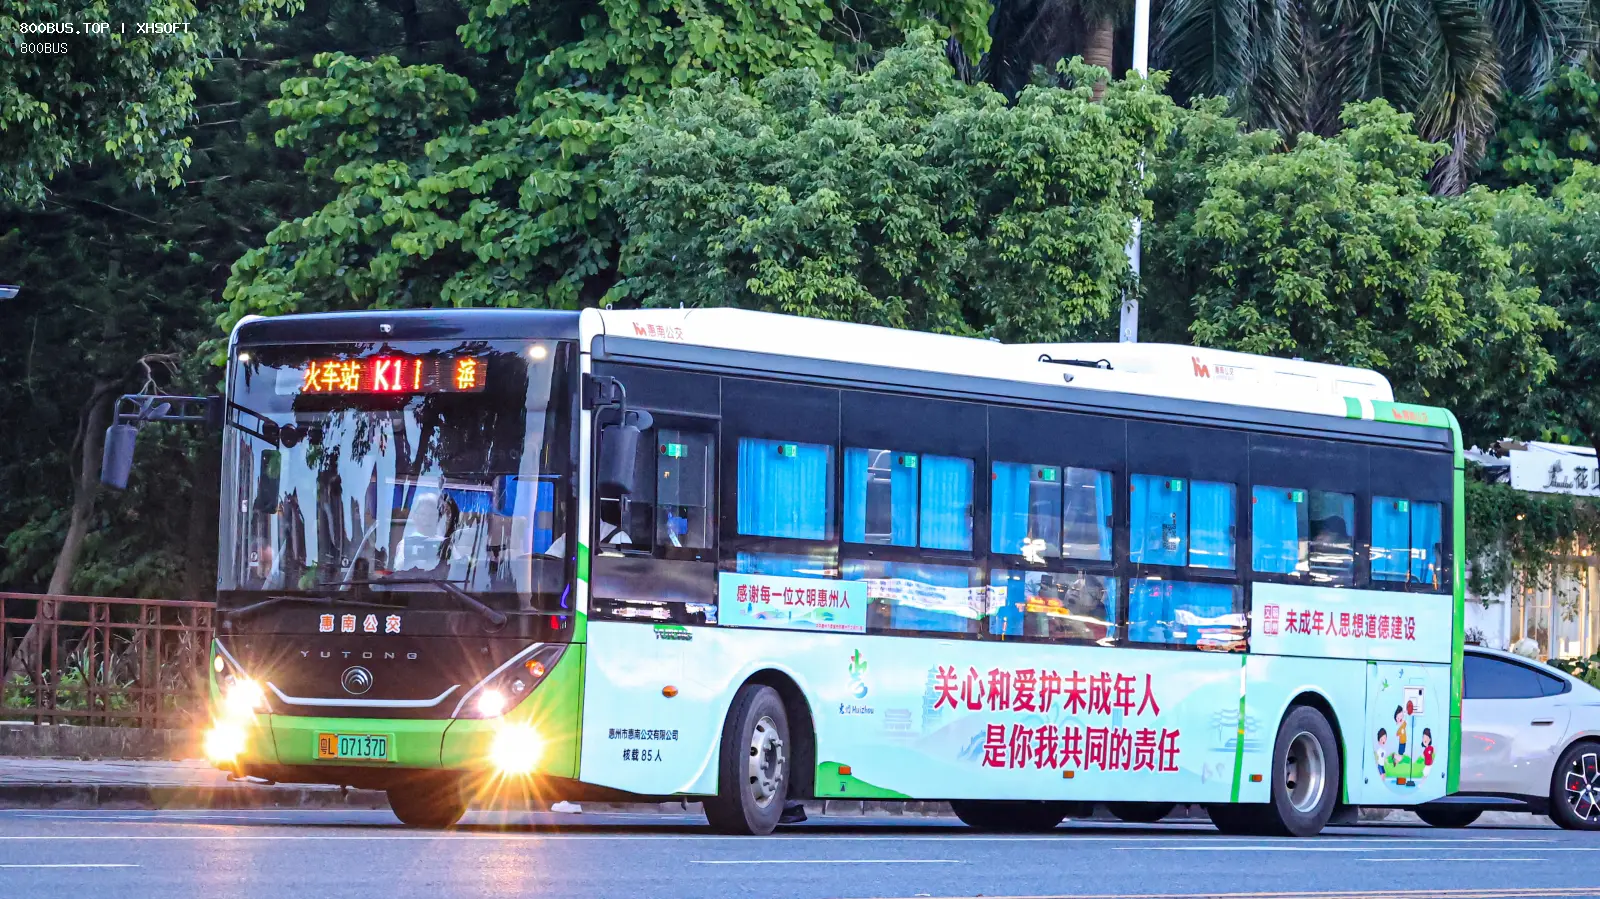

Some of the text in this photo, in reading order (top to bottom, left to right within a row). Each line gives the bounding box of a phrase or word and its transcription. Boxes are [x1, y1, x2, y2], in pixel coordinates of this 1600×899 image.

[647, 324, 684, 340] 惠南公交
[302, 360, 361, 392] 火车站
[736, 583, 851, 609] 感谢每一位文明惠州人
[319, 614, 401, 633] 惠南公交
[1284, 608, 1417, 642] 未成年人思想道德建设
[300, 650, 418, 660] YUTONG
[933, 665, 1161, 717] 关心和爱护未成年人
[608, 728, 679, 741] 惠州市惠南公交有限公司
[981, 723, 1181, 772] 是你我共同的责任
